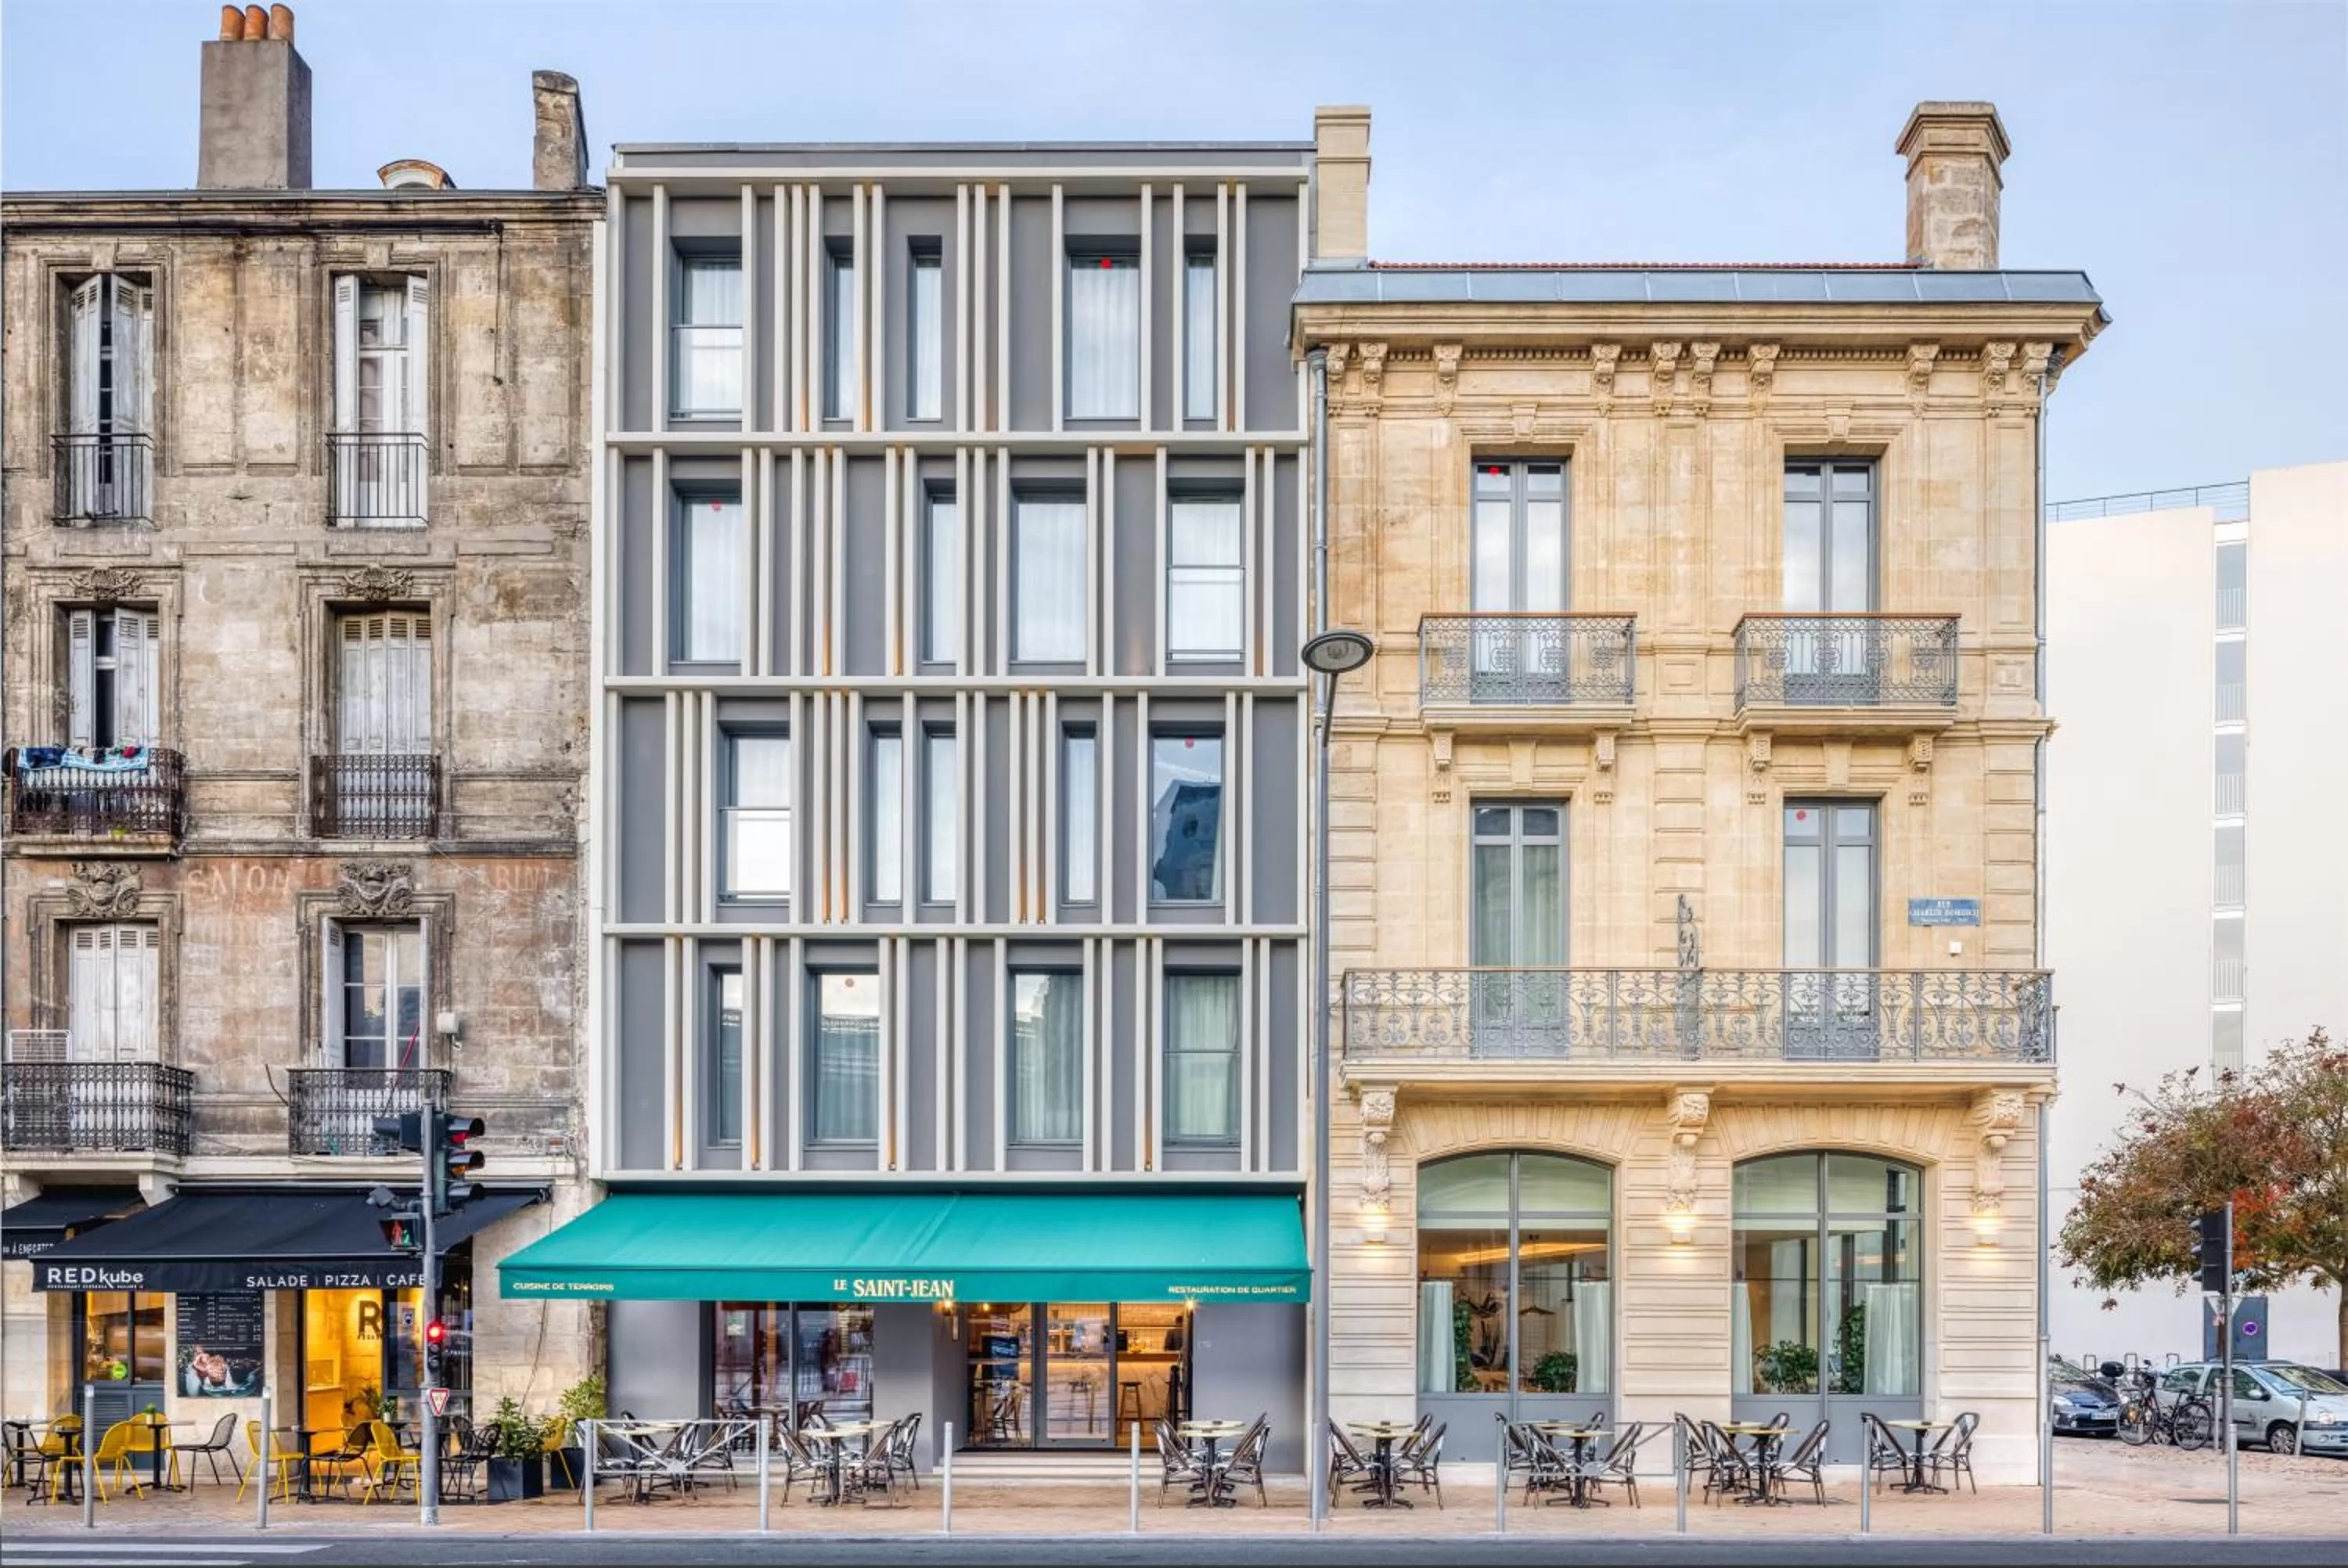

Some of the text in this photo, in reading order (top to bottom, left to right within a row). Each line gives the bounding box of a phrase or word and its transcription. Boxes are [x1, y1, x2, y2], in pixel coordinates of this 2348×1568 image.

[247, 1275, 308, 1287] SALADE
[325, 1274, 370, 1286] PIZZA
[568, 1283, 614, 1292] TERROIRS
[834, 1279, 954, 1297] LE SAINT-JEAN
[1169, 1286, 1235, 1294] RESTAURATION
[1251, 1286, 1296, 1294] QUARTIER
